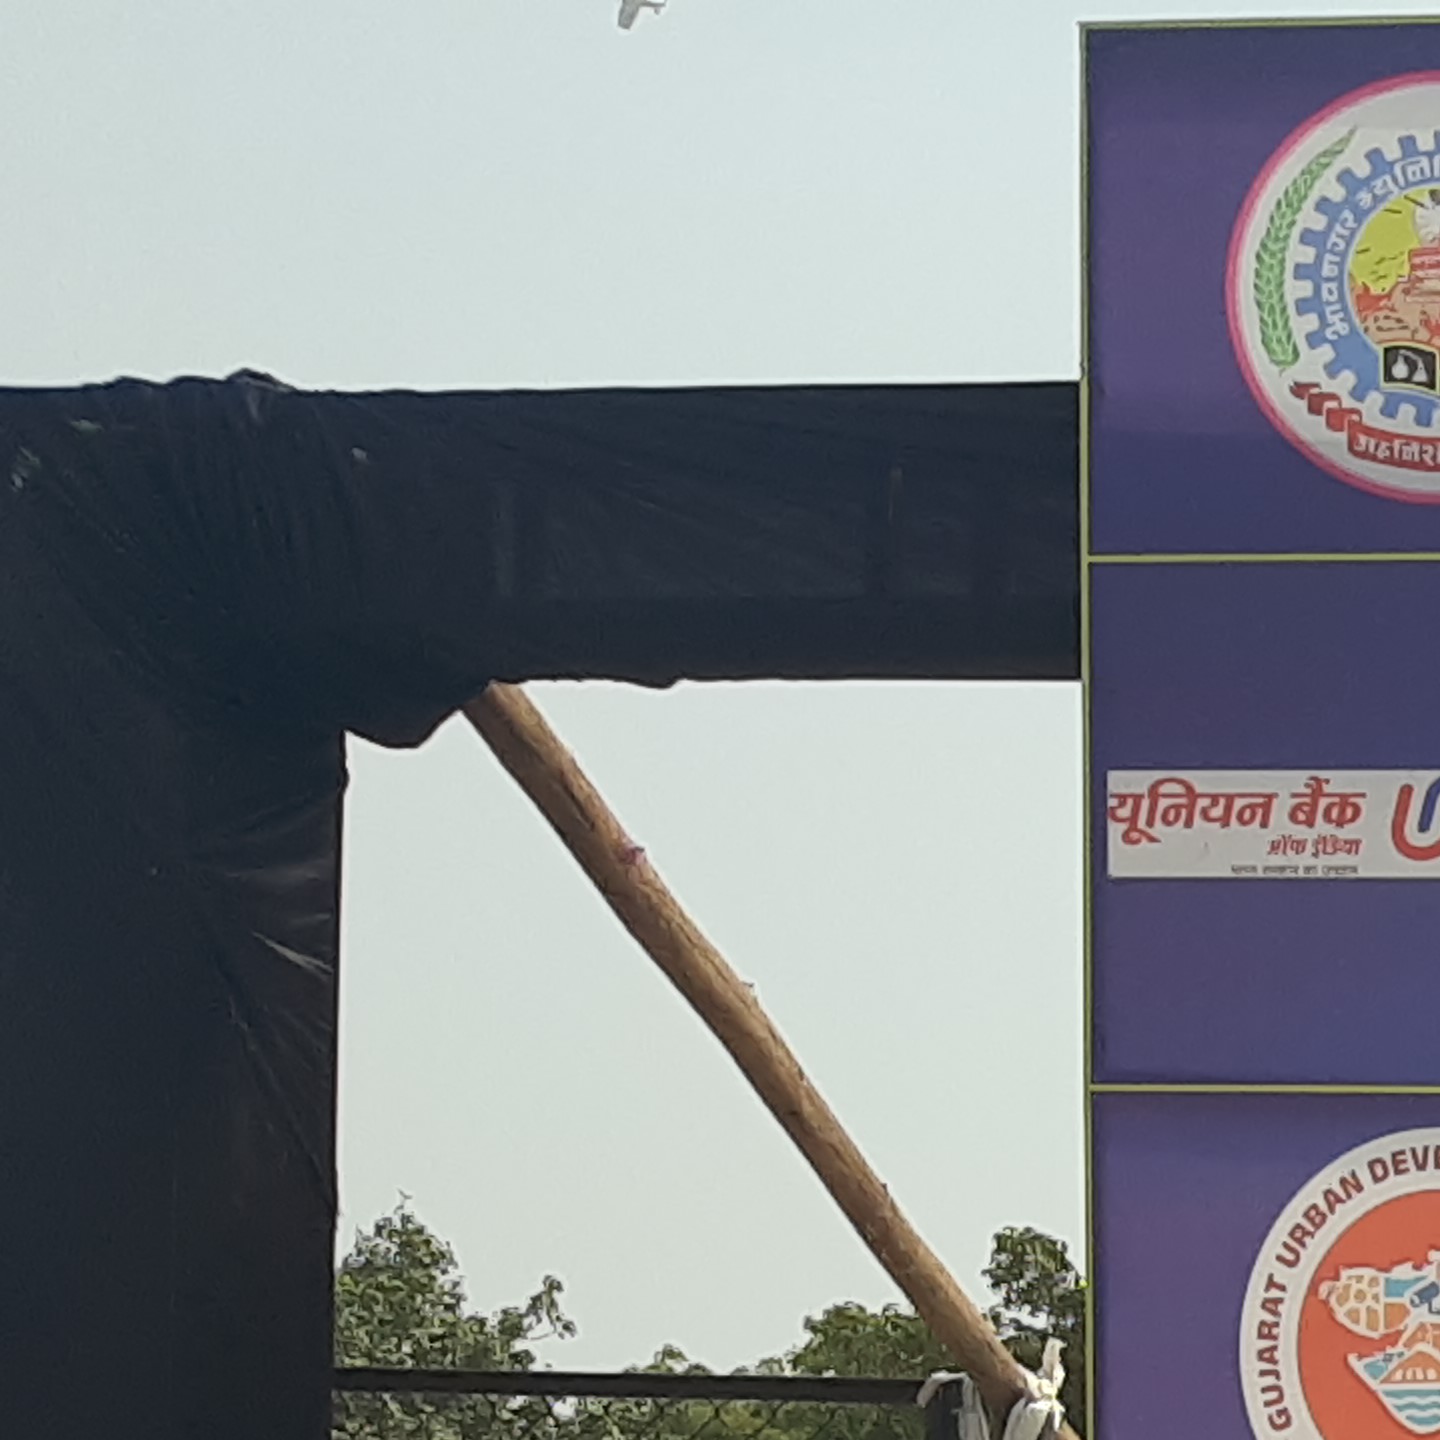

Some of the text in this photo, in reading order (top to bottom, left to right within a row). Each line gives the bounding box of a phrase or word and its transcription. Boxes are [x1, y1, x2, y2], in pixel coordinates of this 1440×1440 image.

[1107, 775, 1367, 845] यूनियन बैंक
[1257, 1273, 1292, 1433] GUJARAT
[1275, 1170, 1365, 1269] URBAN
